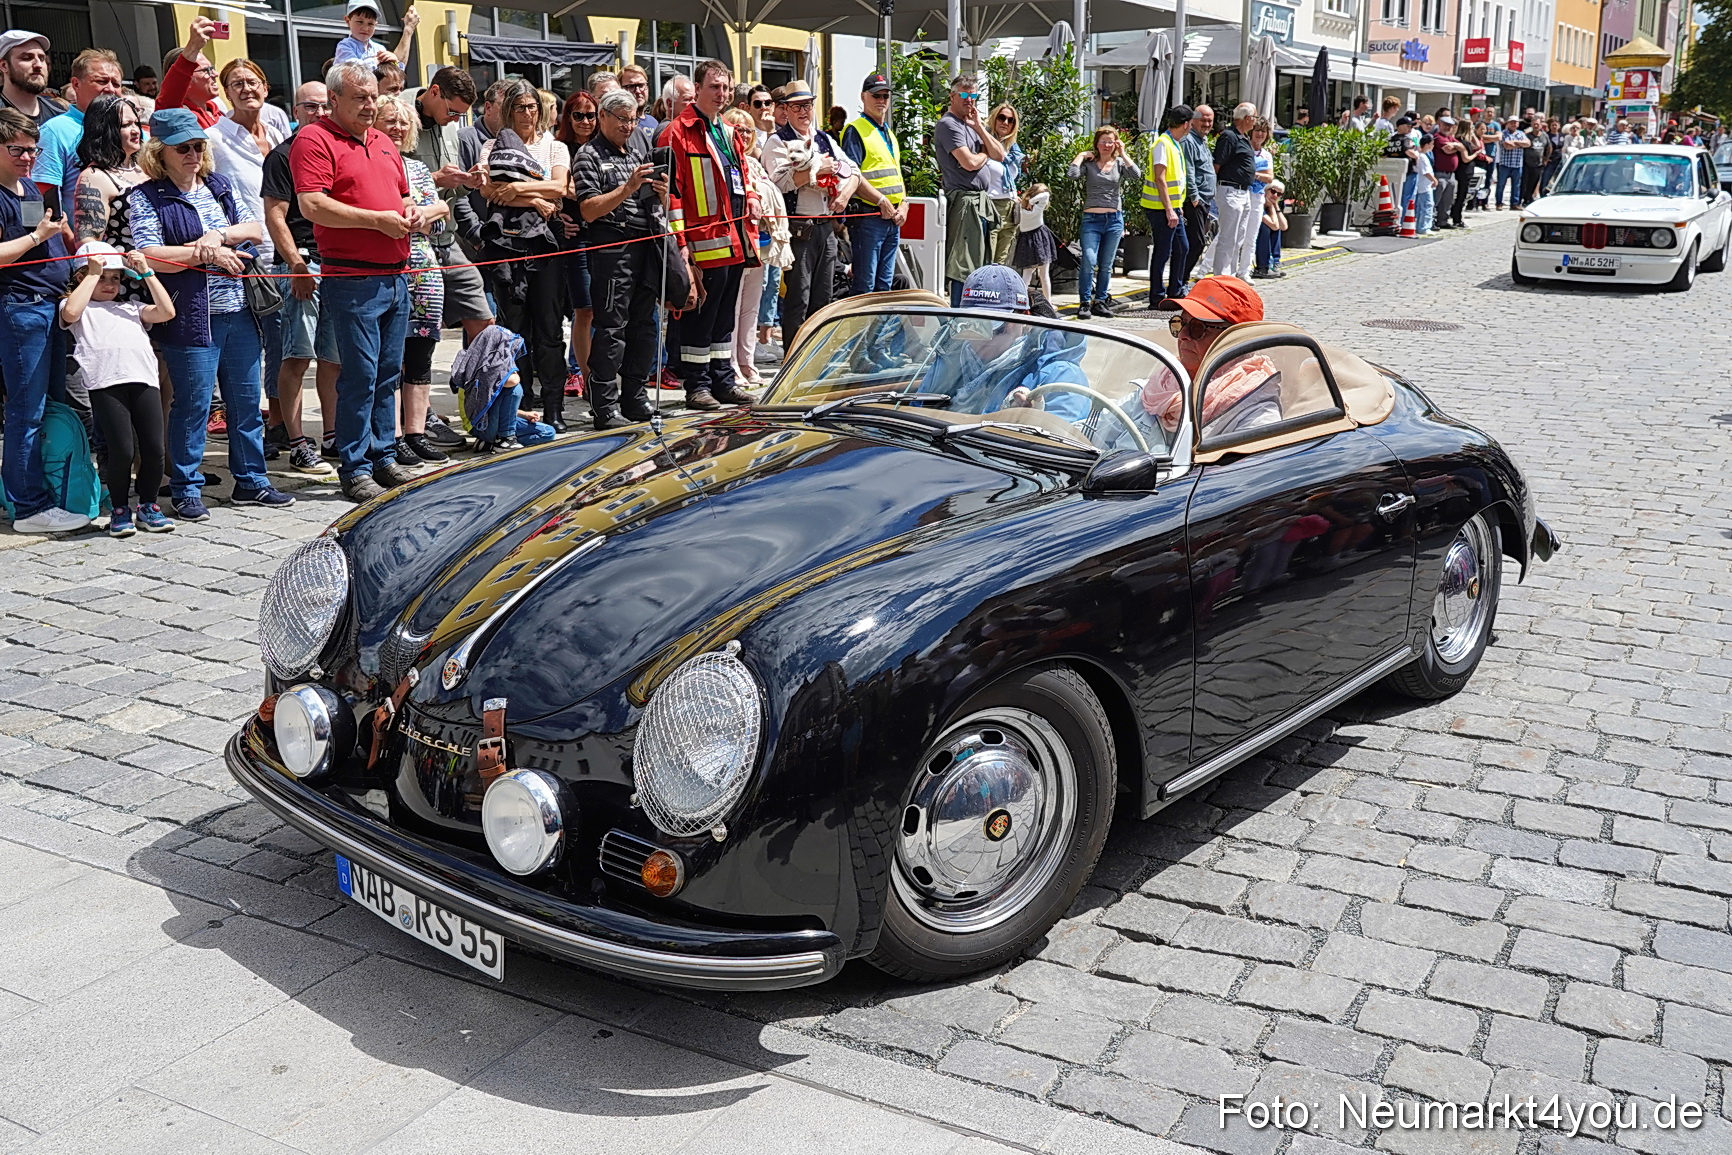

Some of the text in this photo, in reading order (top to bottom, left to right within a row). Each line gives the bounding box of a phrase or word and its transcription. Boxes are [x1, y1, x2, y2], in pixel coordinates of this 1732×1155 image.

[1467, 47, 1486, 55] witt
[1568, 256, 1615, 268] NM AC 52H
[970, 289, 1001, 299] NORWAY
[342, 861, 498, 969] D NAB RS 55
